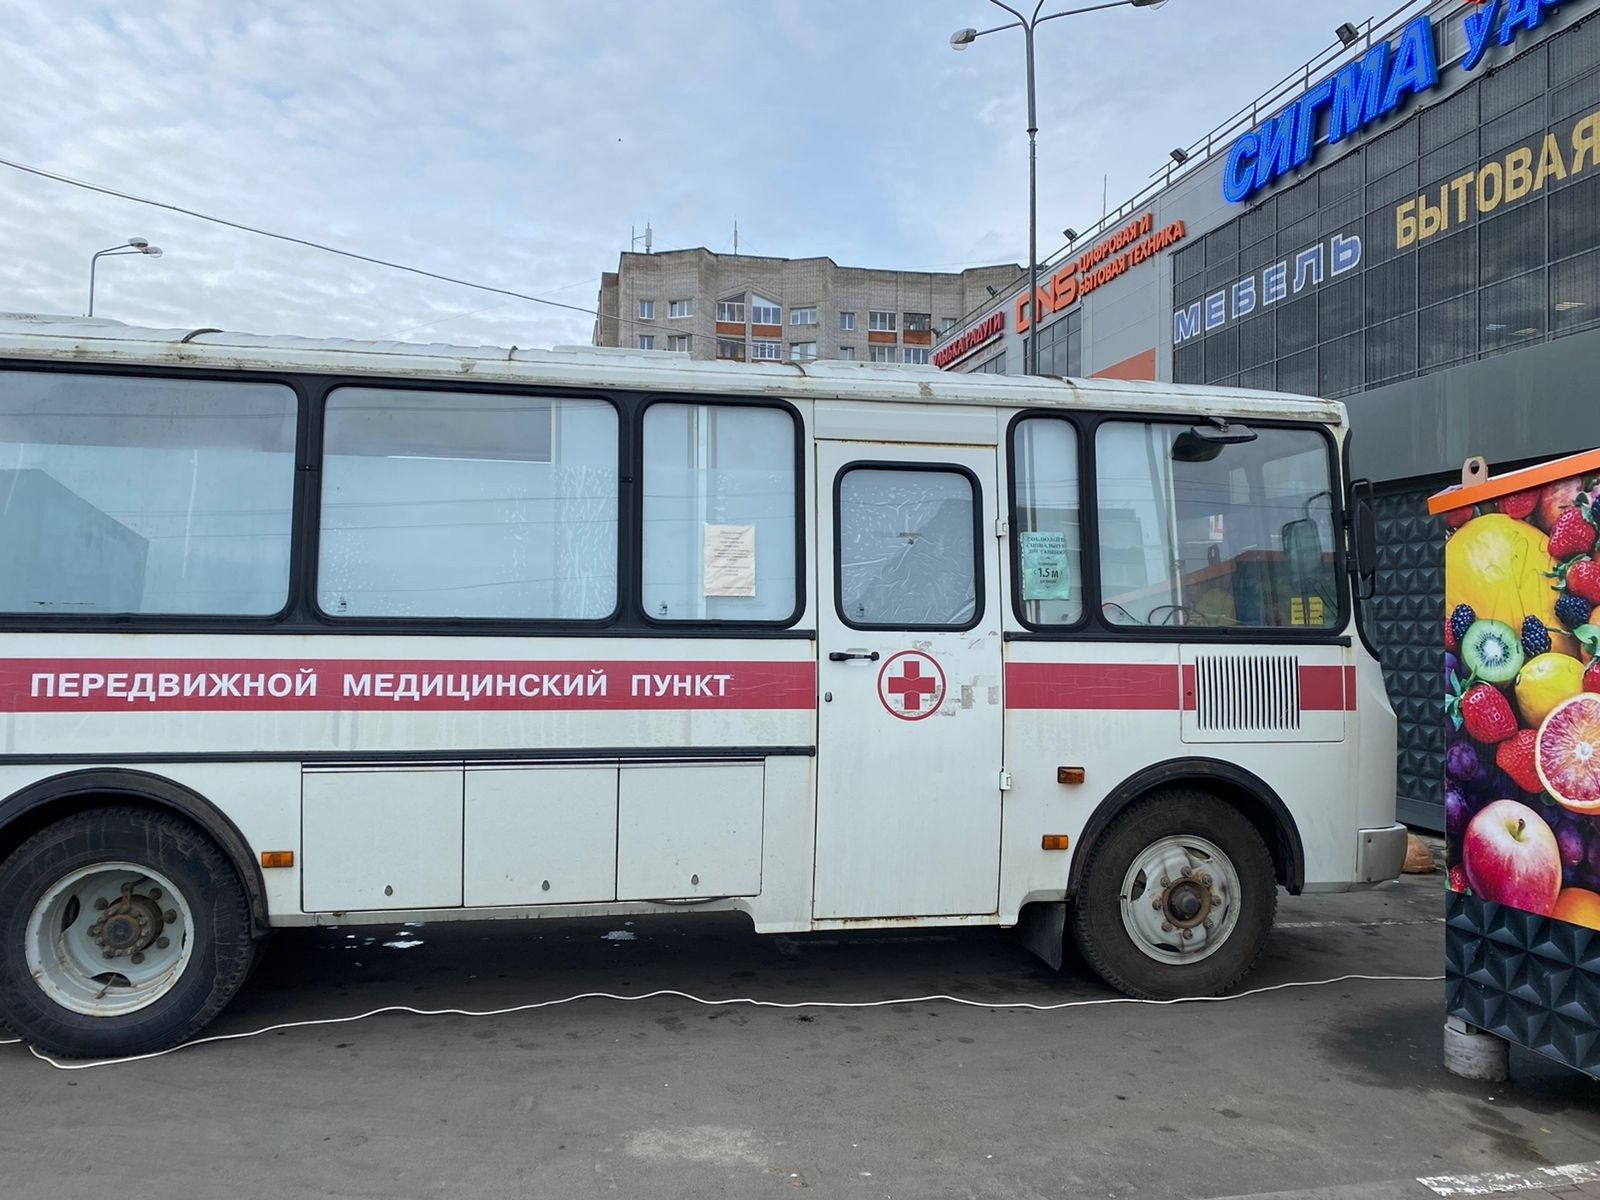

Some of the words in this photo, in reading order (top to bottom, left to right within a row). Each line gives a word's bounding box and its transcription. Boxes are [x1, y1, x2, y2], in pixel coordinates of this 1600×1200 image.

[1223, 15, 1438, 204] СИГМА
[1396, 111, 1600, 250] БЫТОВАЯ
[1079, 220, 1141, 272] ЦИФРОВАЯ
[1140, 213, 1153, 235] И
[1079, 253, 1129, 296] БЫТОВАЯ
[1128, 219, 1186, 267] ТЕХНИКА
[1174, 233, 1362, 344] МЕБЕЛЬ
[30, 667, 318, 702] ПЕРЕДВИЖНОЙ
[343, 668, 608, 702] МЕДИЦИНСКИЙ
[631, 673, 731, 697] ПУНКТ
